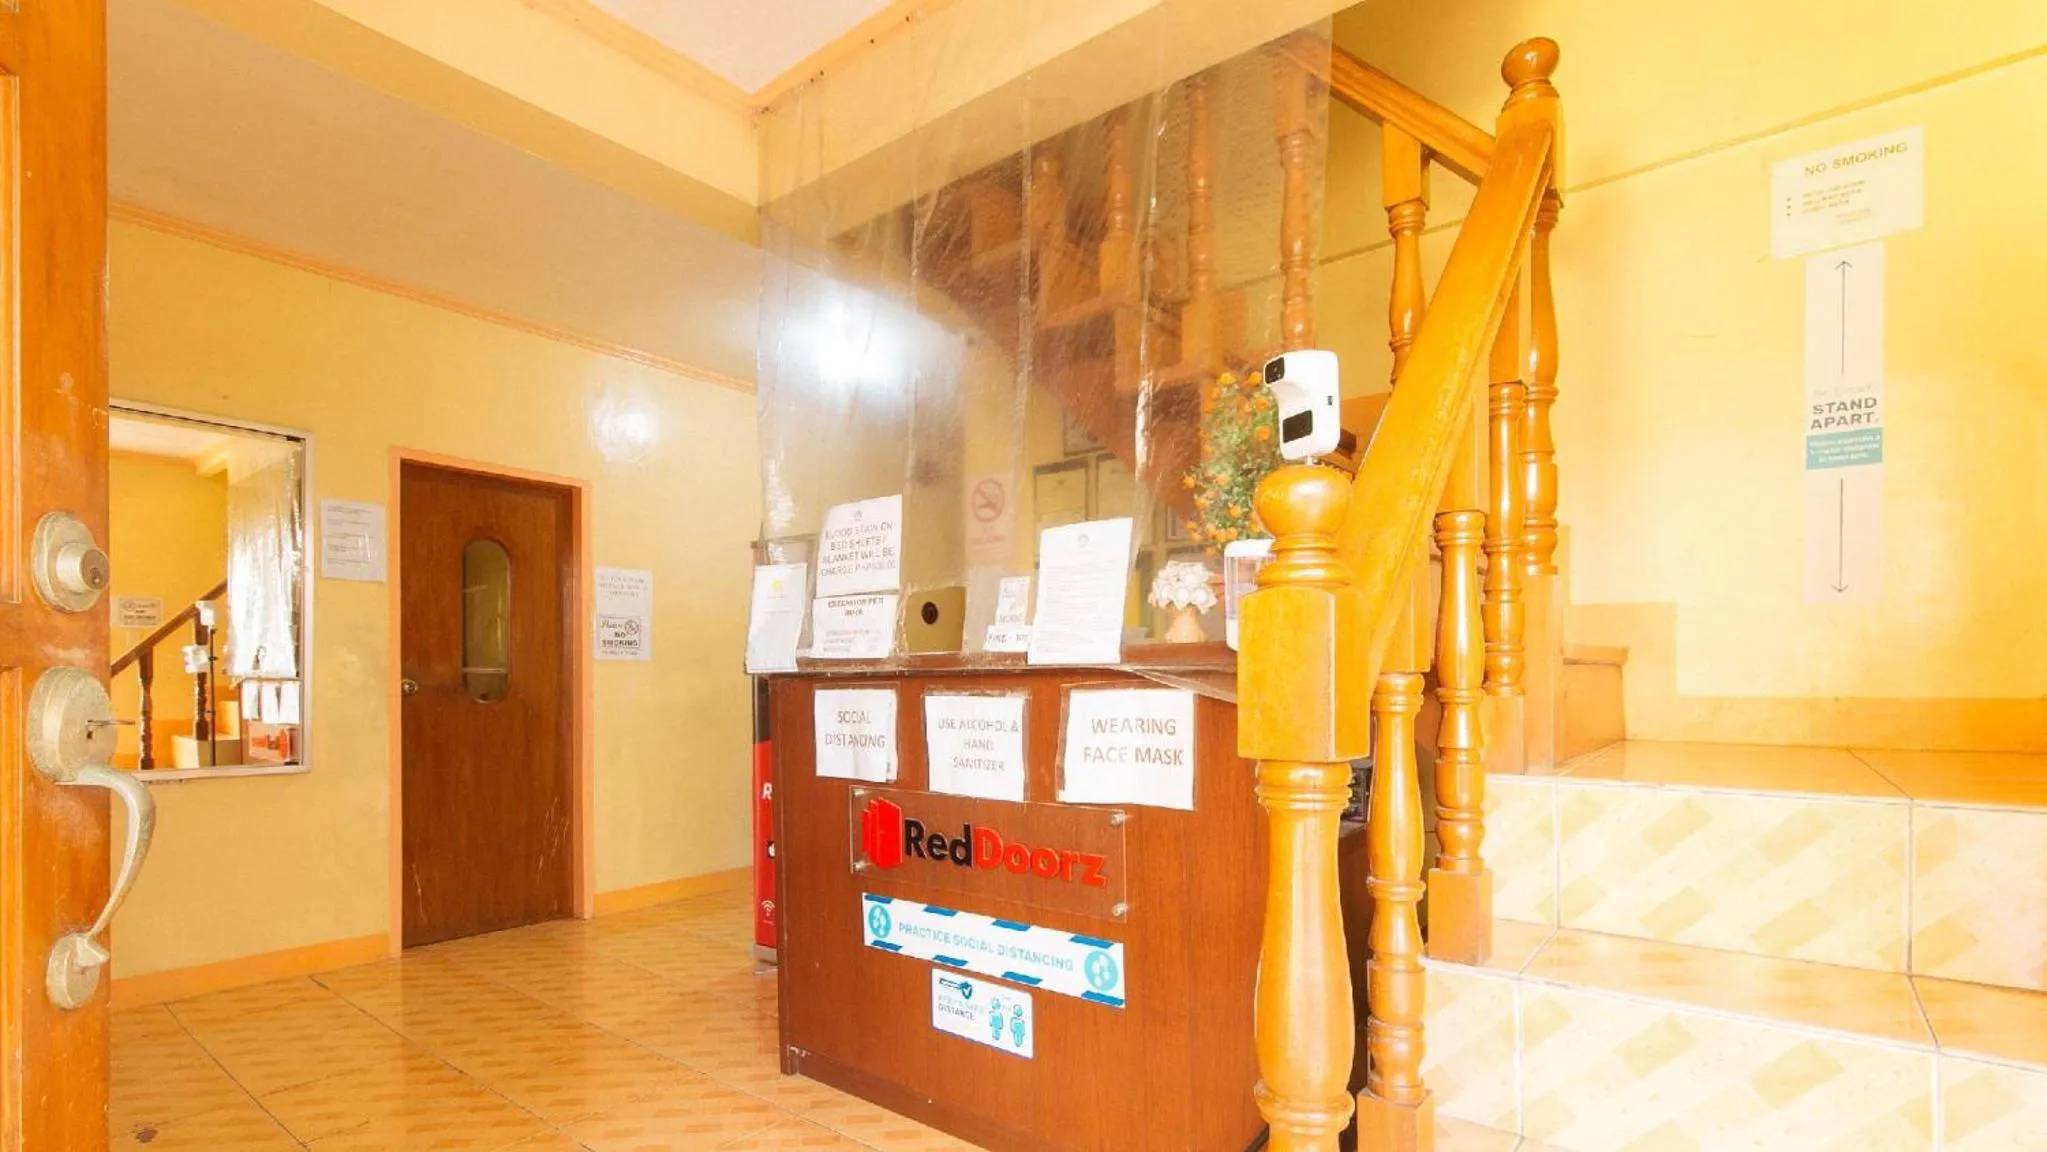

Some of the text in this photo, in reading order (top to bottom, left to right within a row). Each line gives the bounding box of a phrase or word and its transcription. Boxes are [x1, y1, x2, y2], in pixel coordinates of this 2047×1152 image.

[1805, 142, 1908, 176] NO SMOKING
[1812, 397, 1878, 415] STAND
[837, 711, 871, 724] SOCIAL
[938, 718, 956, 730] USE
[1091, 717, 1177, 736] WEARING
[964, 738, 994, 751] HAND
[952, 756, 1006, 772] SANITIZER
[1083, 746, 1185, 766] FACE MASK
[904, 816, 1109, 889] RedDoorz
[898, 922, 1075, 972] PRACTICE SOCIAL DISTANCING
[938, 1003, 976, 1021] DISTANCE
